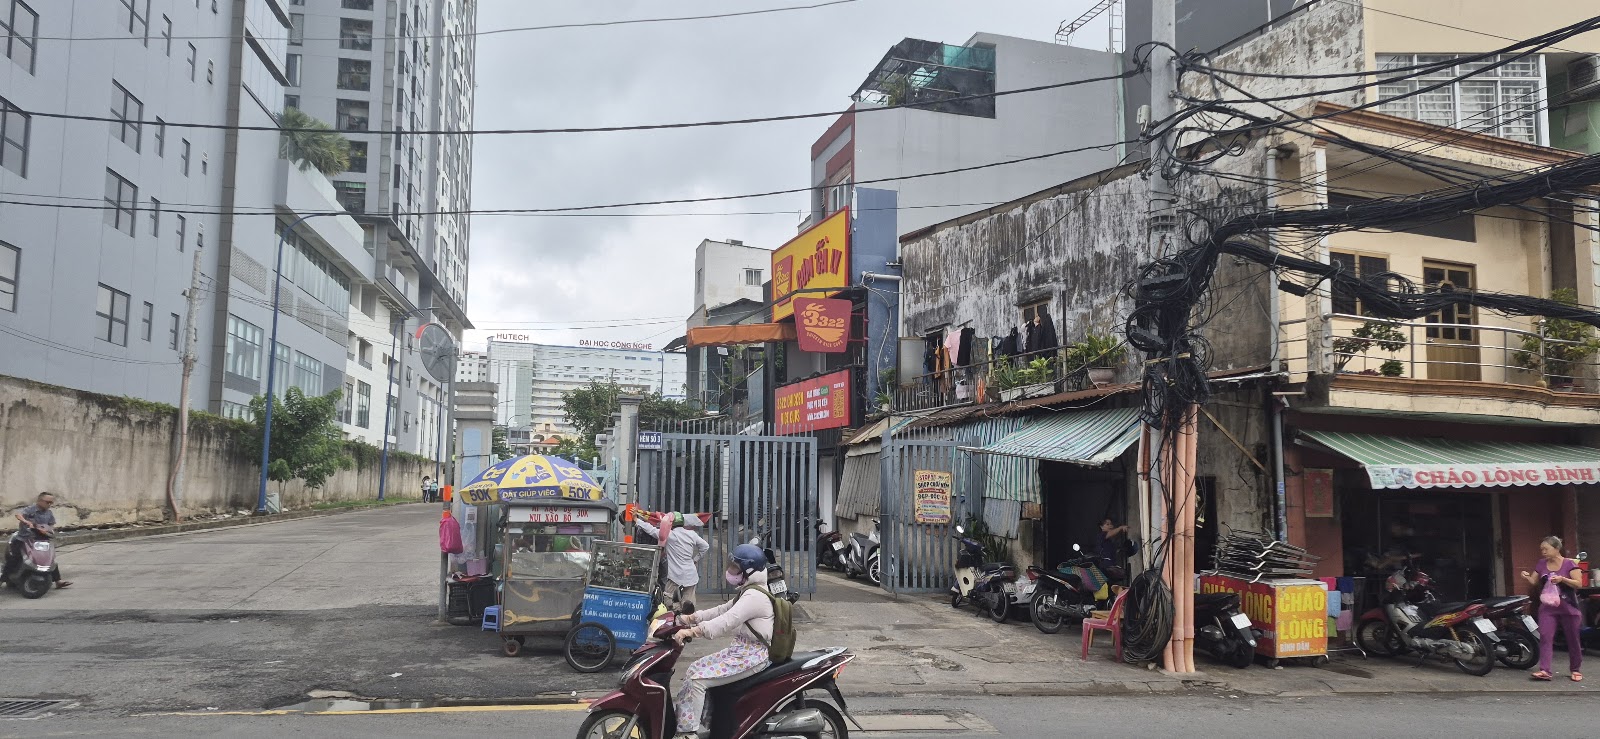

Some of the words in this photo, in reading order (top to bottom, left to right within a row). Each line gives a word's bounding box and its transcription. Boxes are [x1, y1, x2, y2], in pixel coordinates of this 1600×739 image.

[803, 310, 845, 327] 3322
[497, 333, 529, 341] HUTECH
[657, 435, 661, 443] 3
[482, 466, 507, 480] be
[553, 463, 583, 479] be
[1415, 468, 1477, 484] CHÁO
[1482, 467, 1539, 482] LÒNG
[1544, 465, 1594, 481] BÌNH
[470, 488, 492, 501] 50K
[519, 487, 537, 498] GIÚP
[569, 486, 592, 499] 50K
[1280, 588, 1324, 612] CHÁO
[1280, 615, 1324, 640] LÒNG
[1280, 642, 1296, 653] BÌNH
[1296, 641, 1310, 652] DÂN
